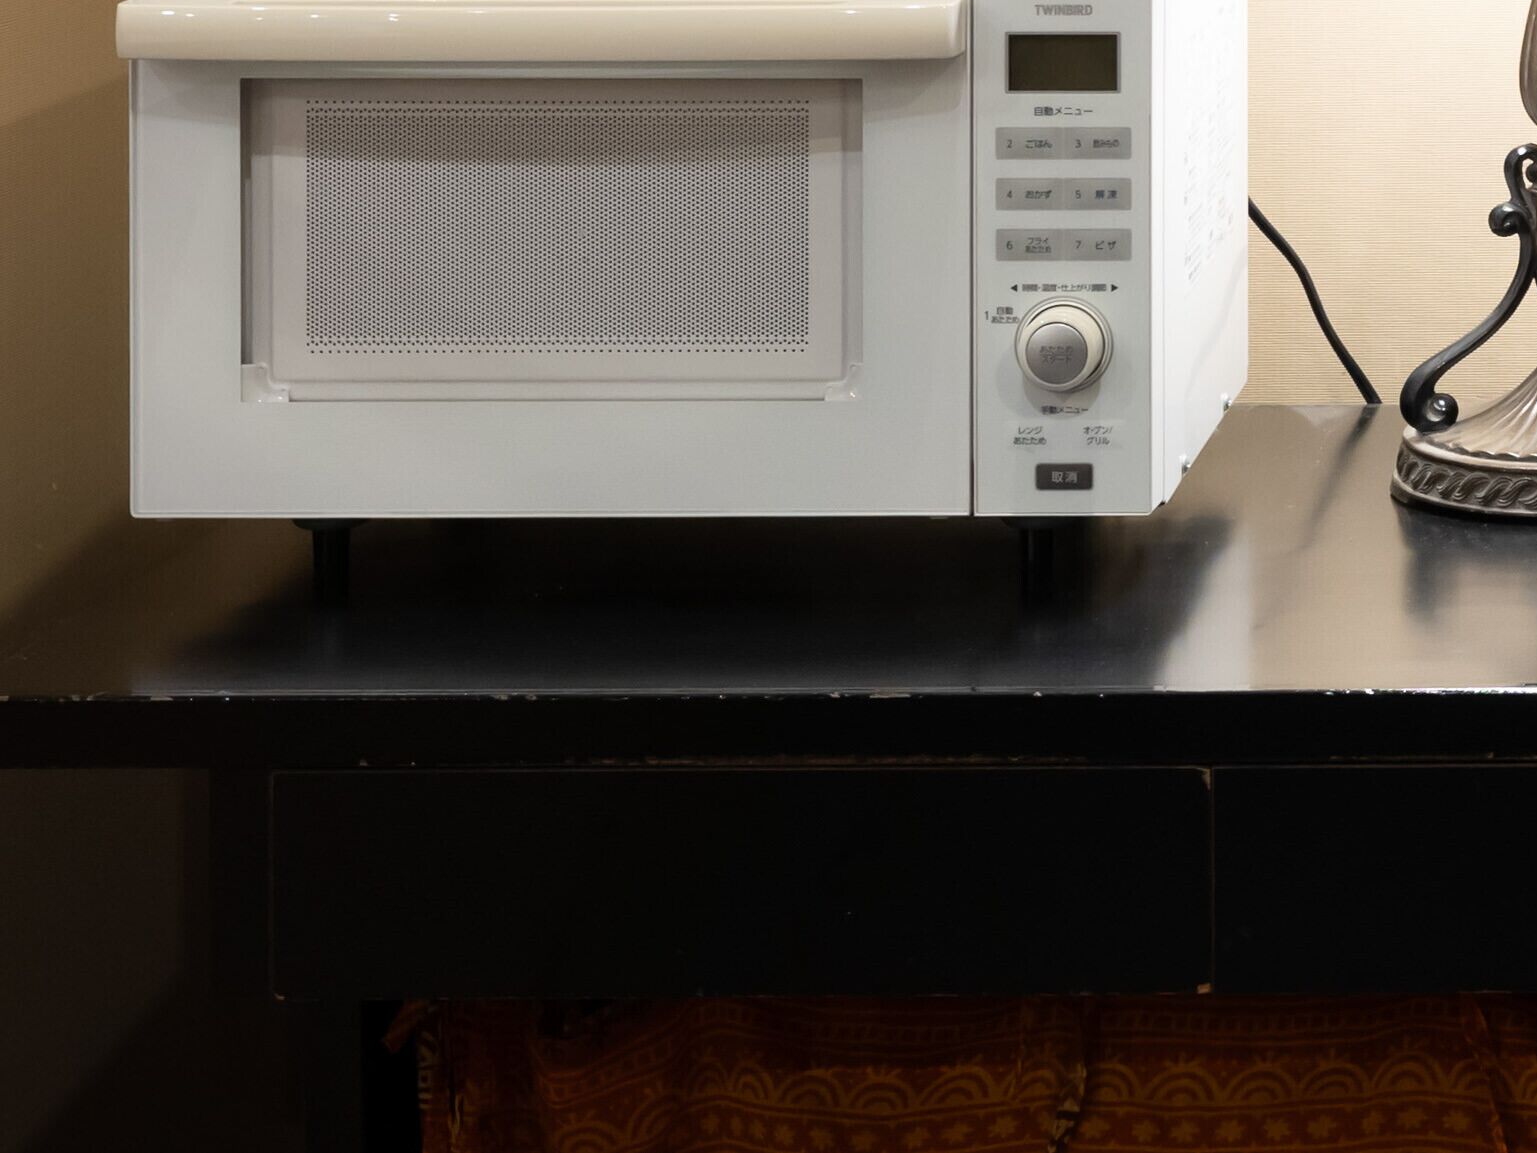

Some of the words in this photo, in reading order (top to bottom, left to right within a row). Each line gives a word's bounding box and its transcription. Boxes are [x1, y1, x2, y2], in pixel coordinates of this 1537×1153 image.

[1034, 4, 1093, 16] TWINBIRD
[1034, 106, 1093, 117] 自動メニュー
[1006, 139, 1013, 149] 2
[1025, 139, 1053, 149] ごはん
[1075, 139, 1082, 149] 3
[1006, 190, 1013, 199] 4
[1075, 190, 1082, 200] 5
[1006, 240, 1013, 250] 6
[1075, 240, 1082, 249] 7
[1018, 425, 1044, 435] レンジ
[1086, 436, 1111, 446] グリル
